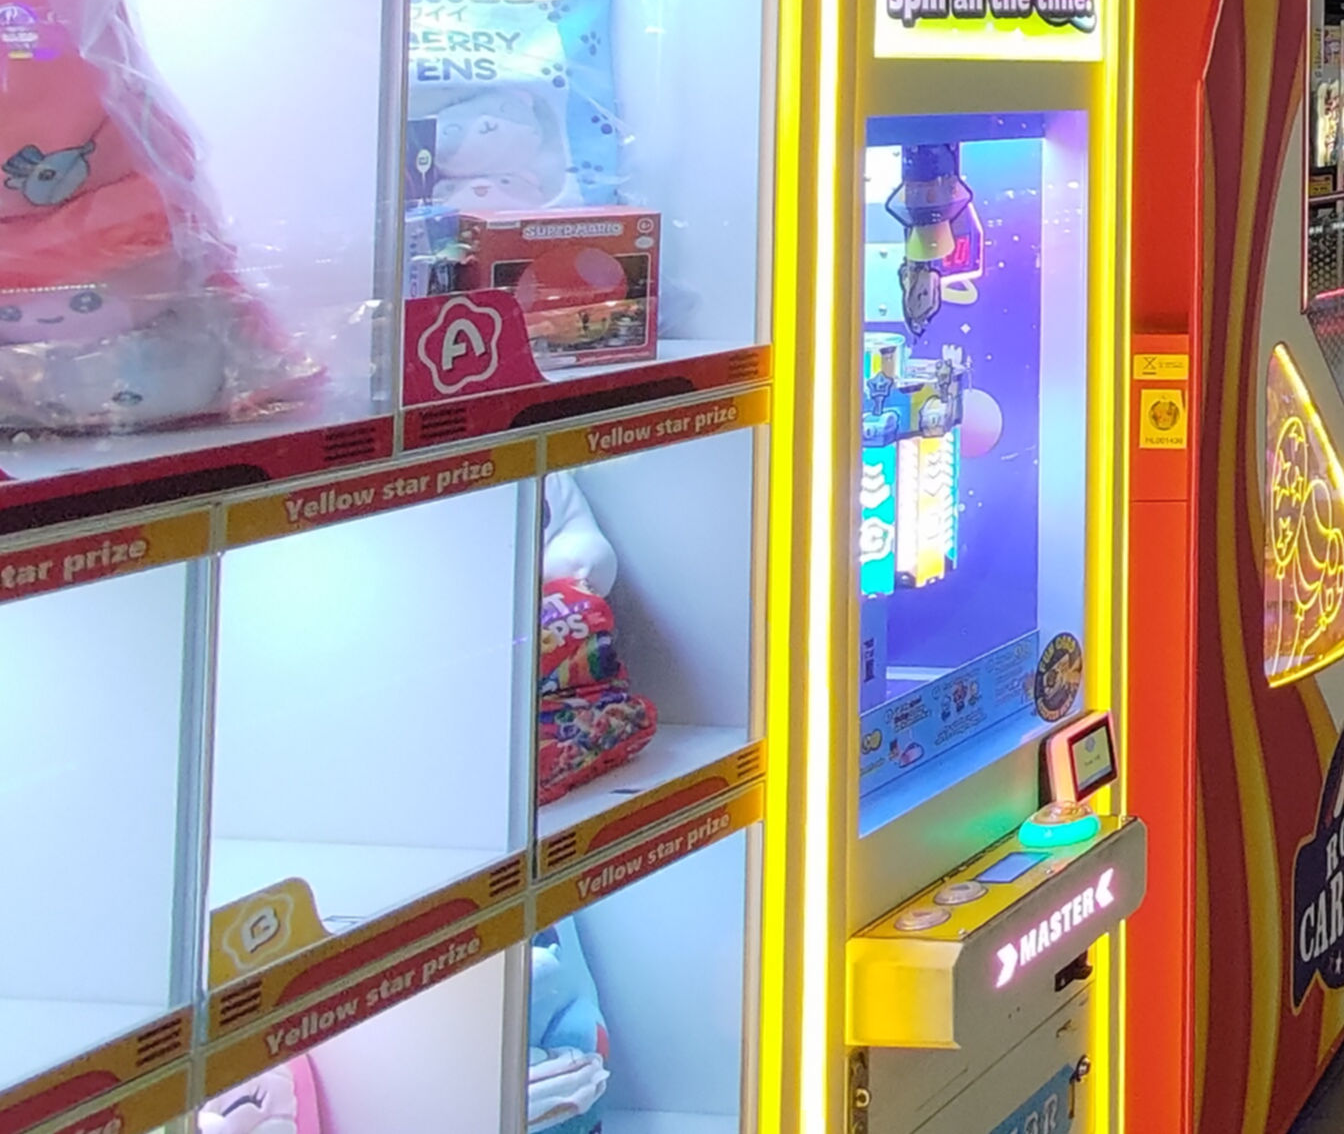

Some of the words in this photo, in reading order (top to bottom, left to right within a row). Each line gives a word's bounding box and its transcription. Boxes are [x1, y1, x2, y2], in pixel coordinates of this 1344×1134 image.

[588, 423, 651, 452] Yellow
[656, 417, 690, 438] star
[695, 405, 738, 435] prize
[286, 485, 375, 523] Yellow
[383, 472, 428, 501] star
[437, 459, 493, 495] prize
[63, 538, 148, 582] prize
[577, 854, 642, 900] Yellow
[648, 835, 683, 865] star
[687, 811, 731, 853] prize
[241, 905, 279, 954] B
[1020, 887, 1096, 967] MASTER
[265, 994, 359, 1056] Yellow
[366, 968, 413, 1008] star
[421, 934, 481, 977] prize
